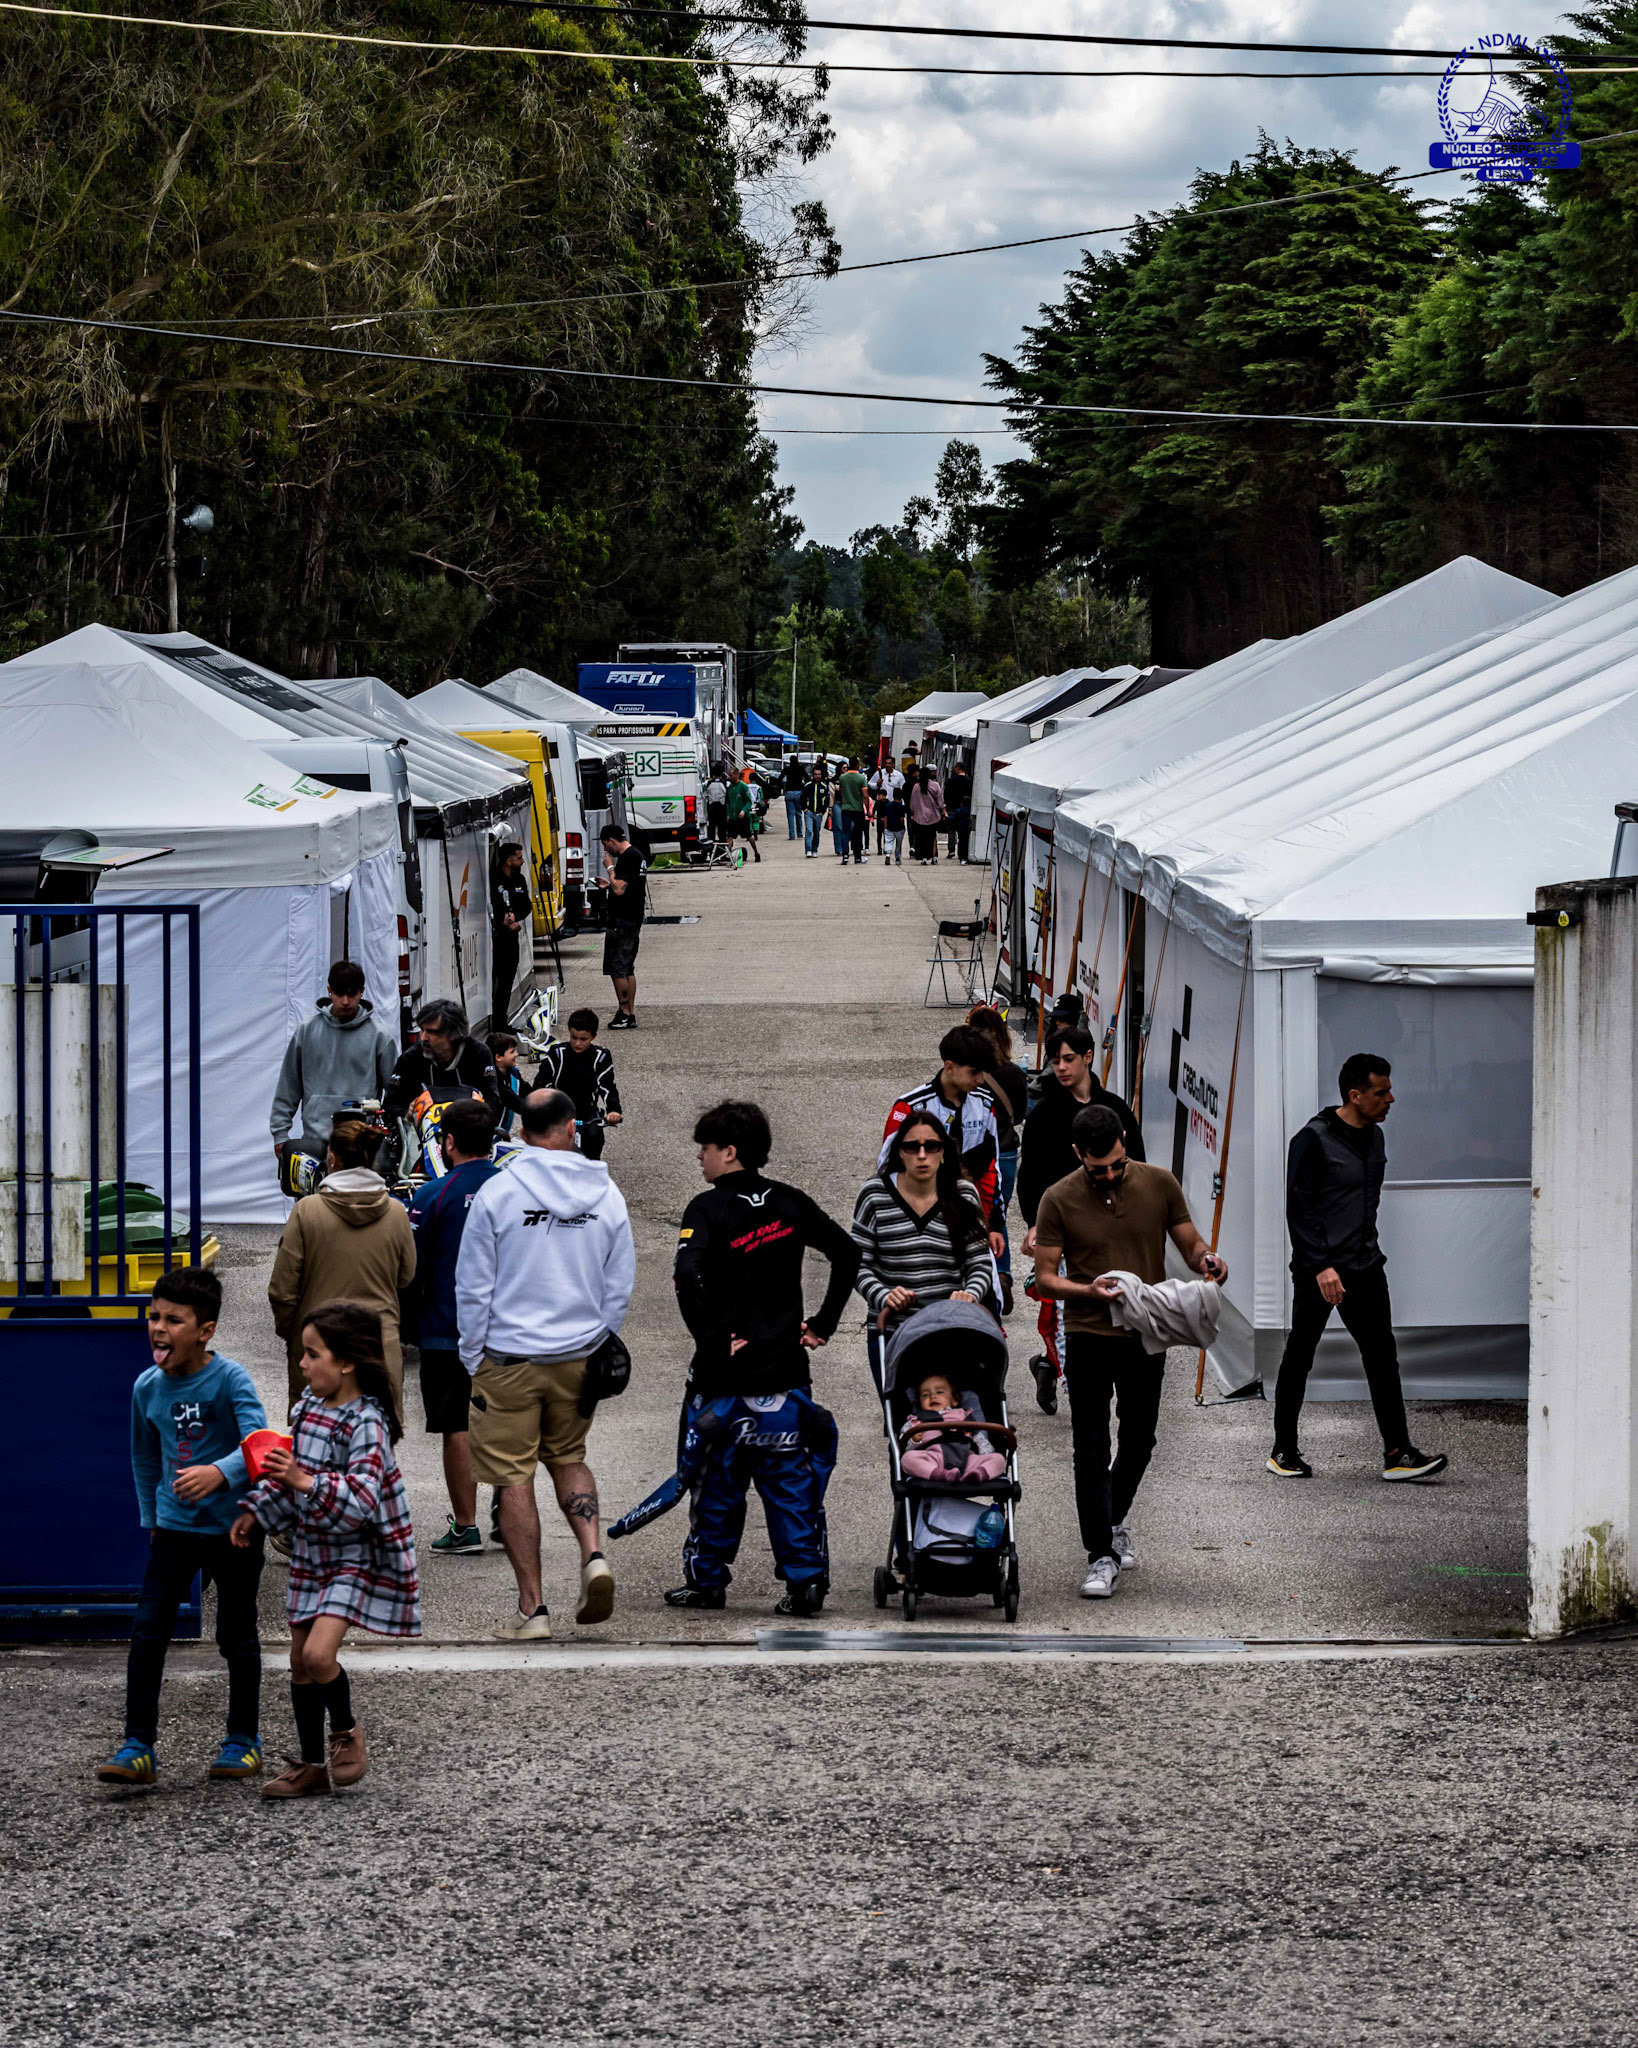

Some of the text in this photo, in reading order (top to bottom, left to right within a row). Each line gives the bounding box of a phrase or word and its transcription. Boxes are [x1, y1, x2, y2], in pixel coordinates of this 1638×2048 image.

[603, 727, 616, 735] PARA
[618, 726, 655, 735] PROFISSIONAIS
[730, 1416, 800, 1452] Praga
[622, 1498, 662, 1530] Praga
